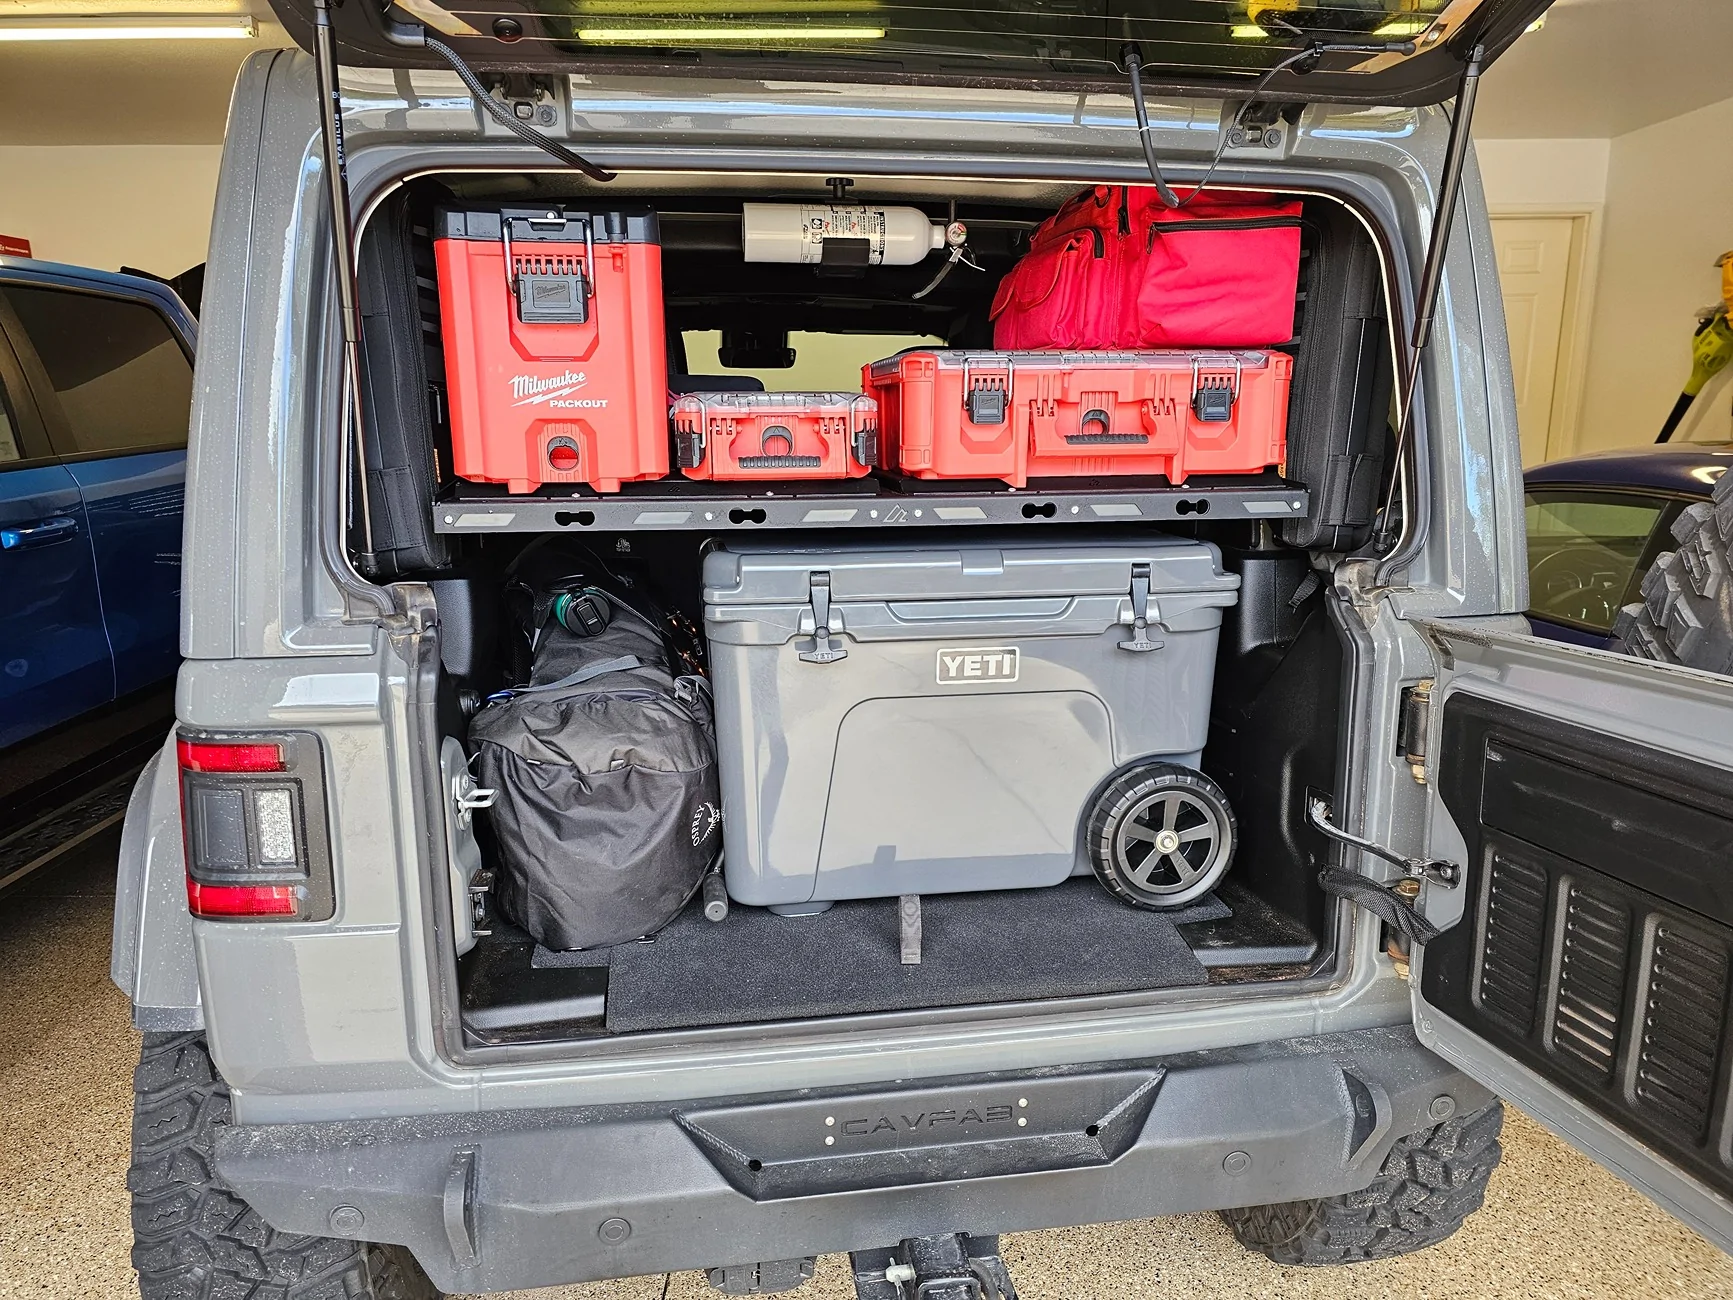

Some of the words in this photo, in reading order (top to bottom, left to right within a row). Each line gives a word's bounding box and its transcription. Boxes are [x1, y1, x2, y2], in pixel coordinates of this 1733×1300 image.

[335, 113, 343, 165] STABILUS
[508, 369, 587, 399] Milwaukee
[549, 399, 608, 408] PACKOUT
[815, 652, 834, 660] YETI
[942, 654, 1012, 677] YETI
[691, 804, 705, 847] OSPREY
[840, 1105, 1013, 1136] CAVFAB
